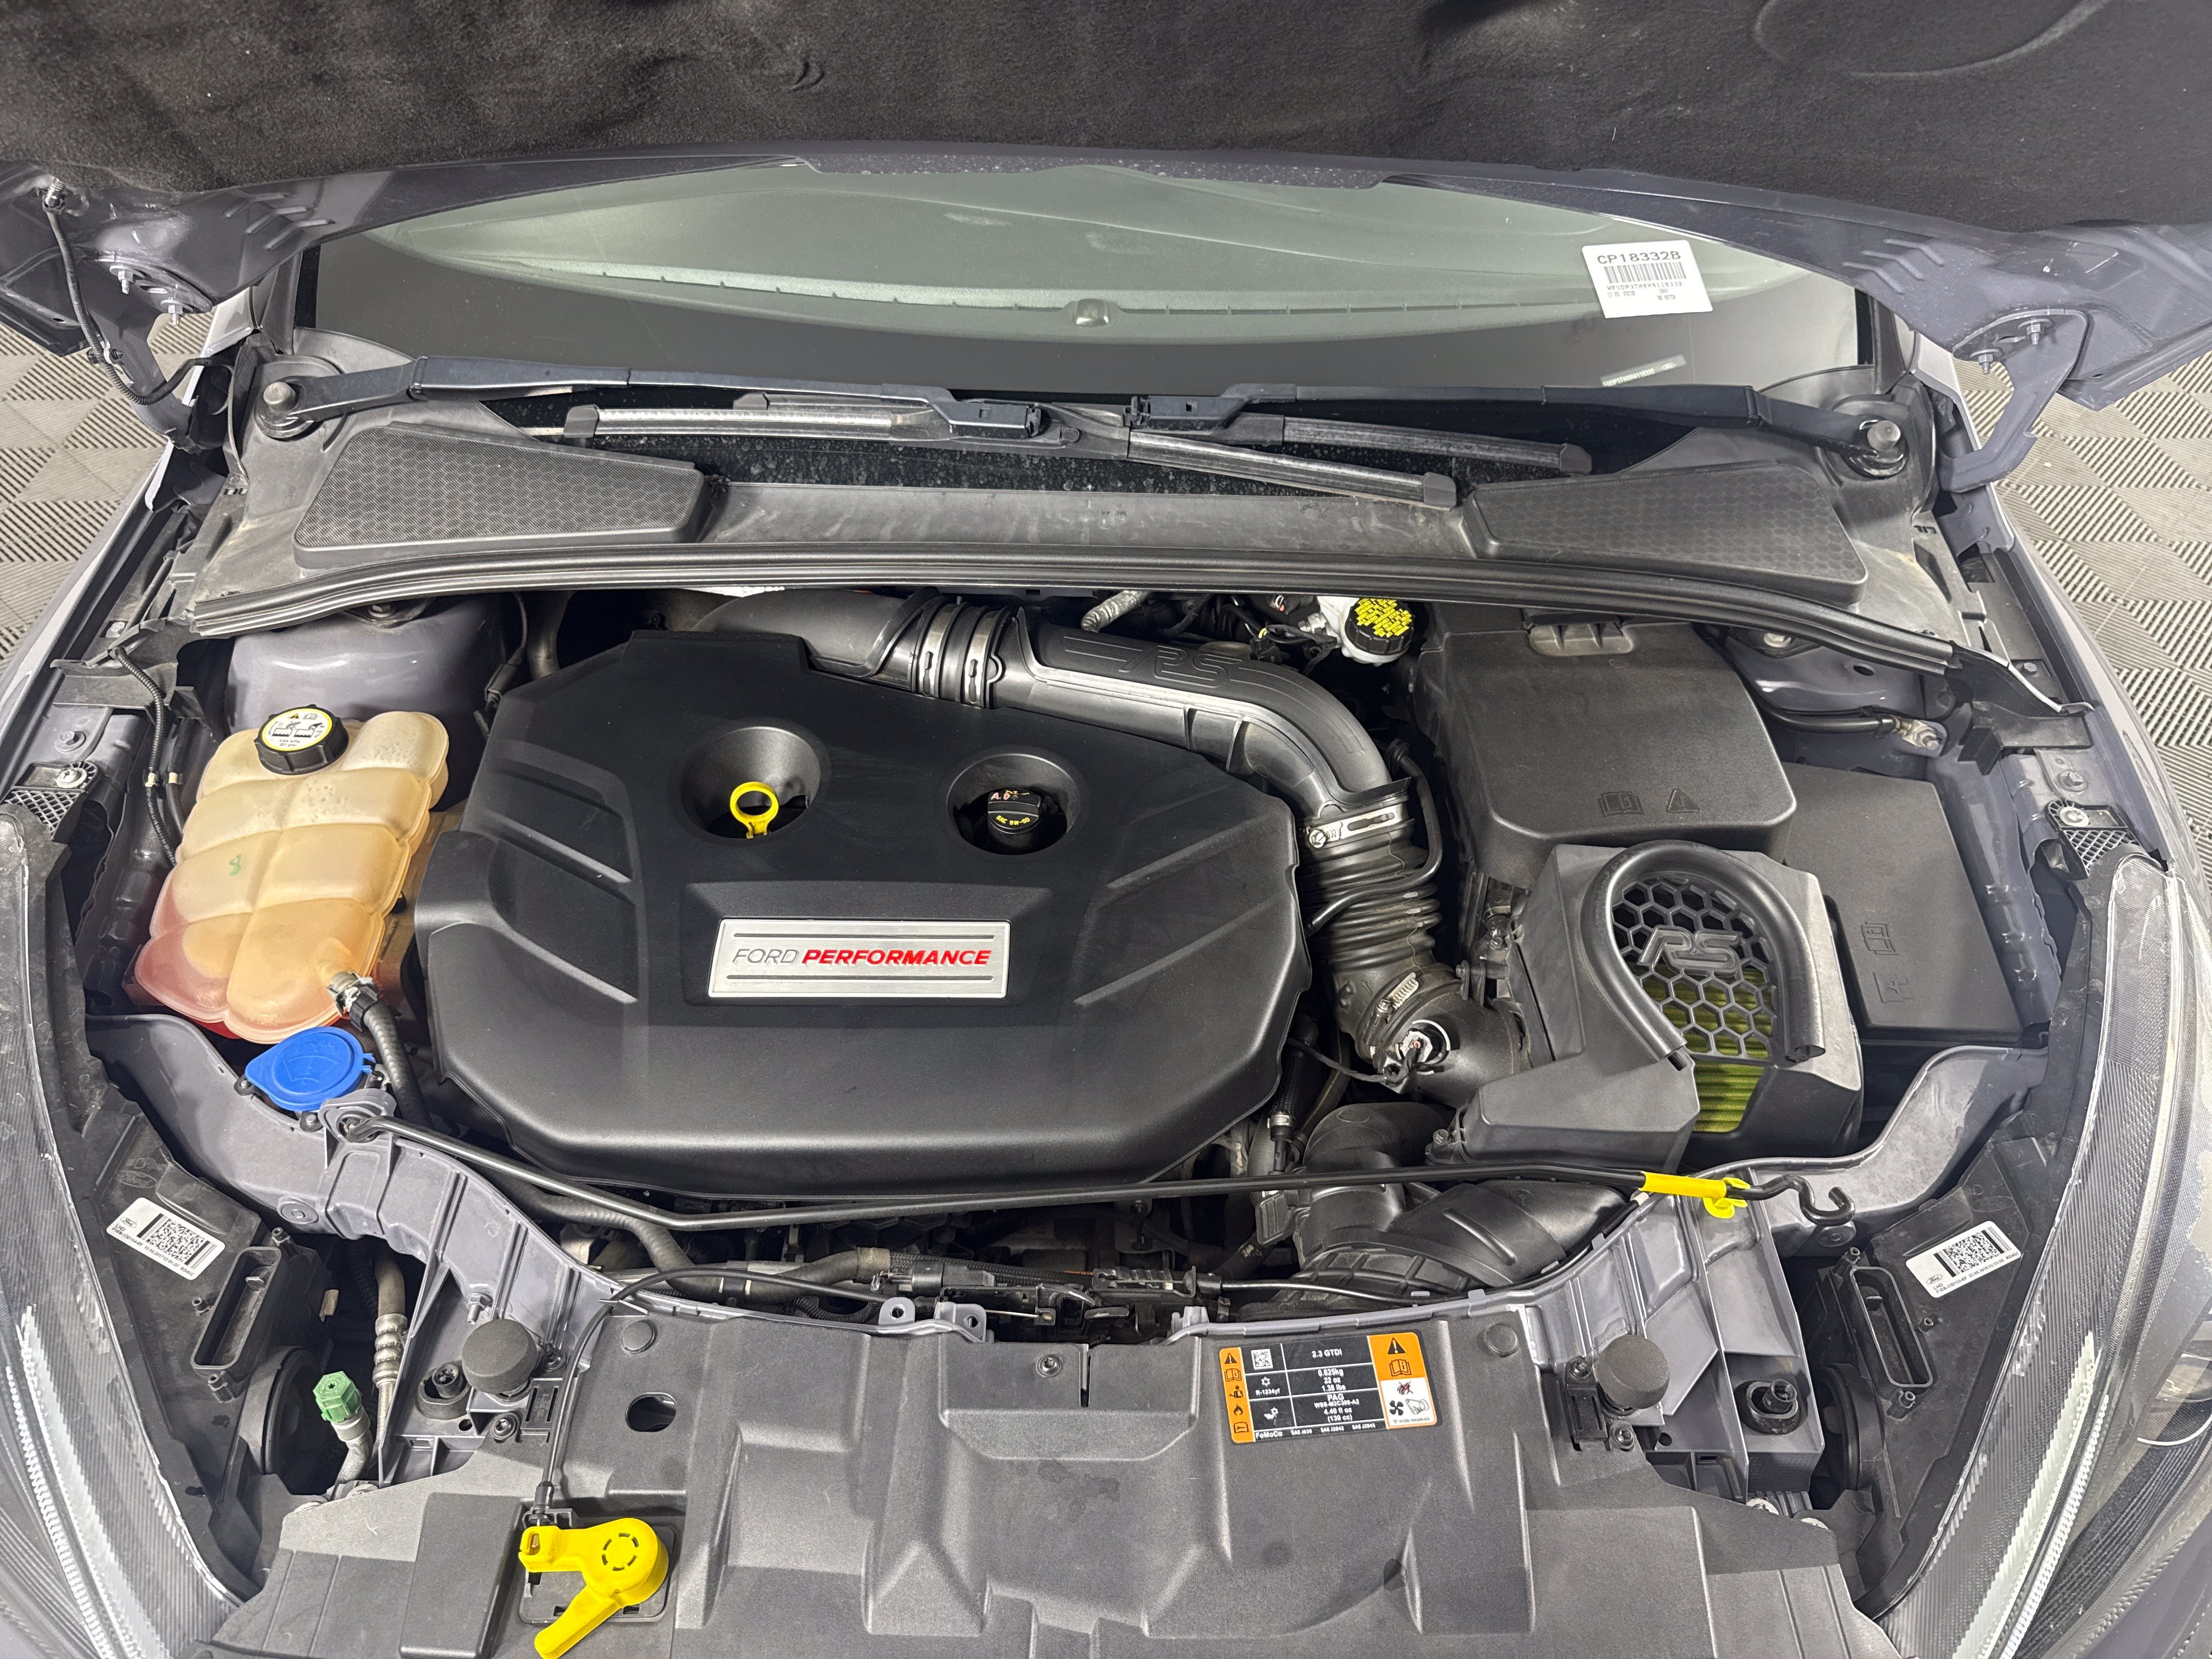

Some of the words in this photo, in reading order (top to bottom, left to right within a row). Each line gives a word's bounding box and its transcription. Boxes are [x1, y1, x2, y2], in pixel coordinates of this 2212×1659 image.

[1597, 251, 1681, 264] CP18332B
[996, 815, 1008, 824] SAE
[1009, 817, 1030, 825] 5W-50
[1637, 924, 1743, 973] RS
[732, 949, 799, 964] FORD
[802, 949, 992, 966] PERFORMANCE
[1311, 1350, 1323, 1359] 2.3
[1324, 1348, 1342, 1357] GTDI
[1318, 1368, 1344, 1377] 0.625kg
[1255, 1431, 1283, 1439] FoMoCo
